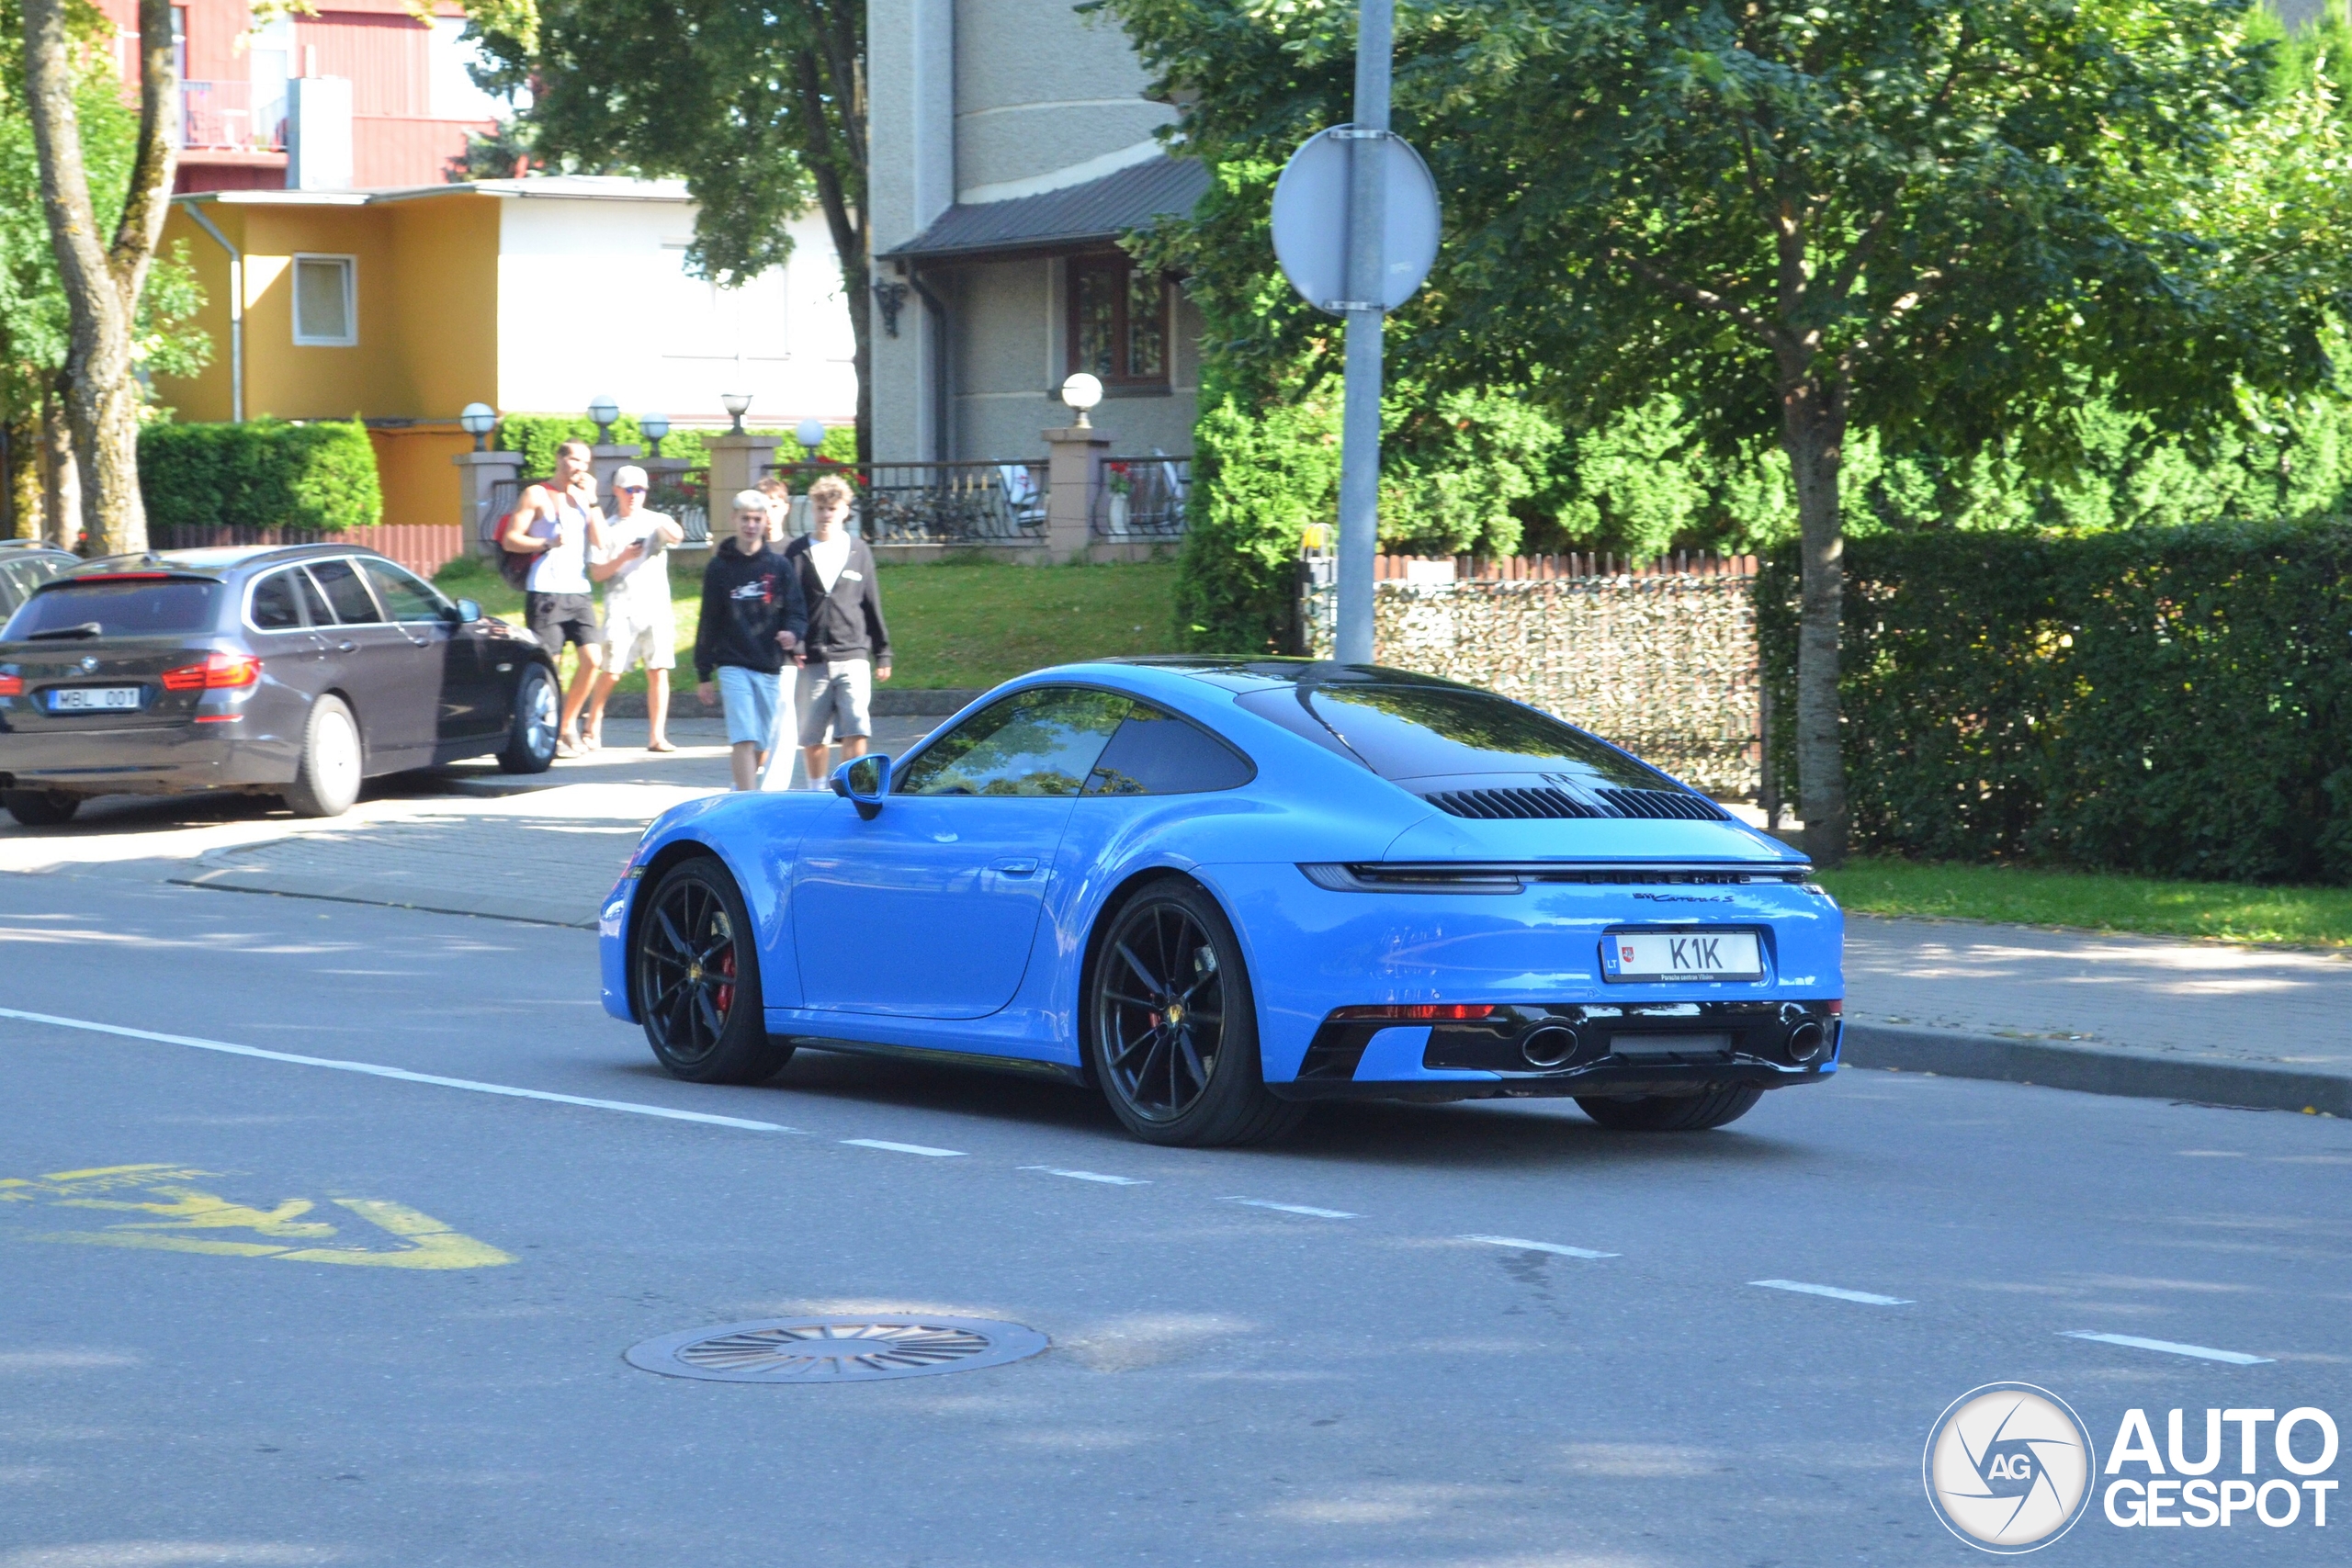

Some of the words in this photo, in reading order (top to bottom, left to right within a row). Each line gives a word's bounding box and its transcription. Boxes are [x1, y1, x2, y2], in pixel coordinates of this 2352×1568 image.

[107, 690, 134, 705] 001
[1653, 894, 1708, 902] Carrera
[1669, 938, 1723, 969] K1K
[1607, 959, 1617, 968] LT
